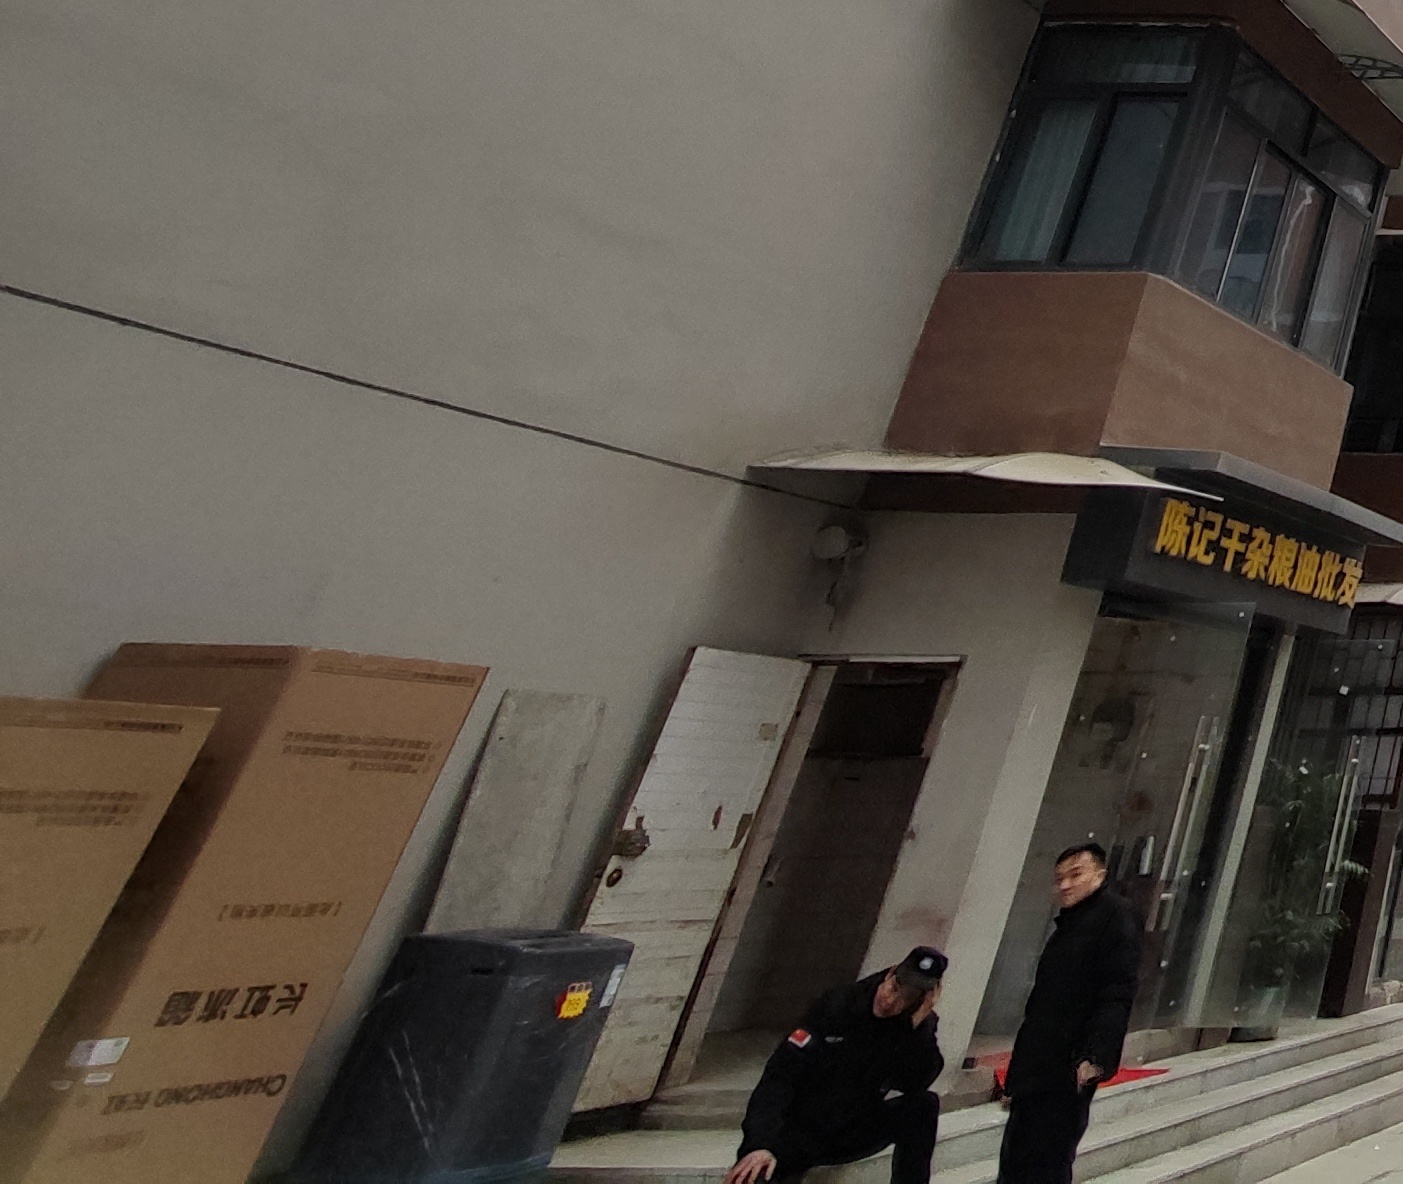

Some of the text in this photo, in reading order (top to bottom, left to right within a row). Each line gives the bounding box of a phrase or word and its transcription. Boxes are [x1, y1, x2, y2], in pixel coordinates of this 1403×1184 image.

[1154, 498, 1363, 609] 陈记干杂粮油批发
[154, 982, 308, 1028] 长虹冰箱
